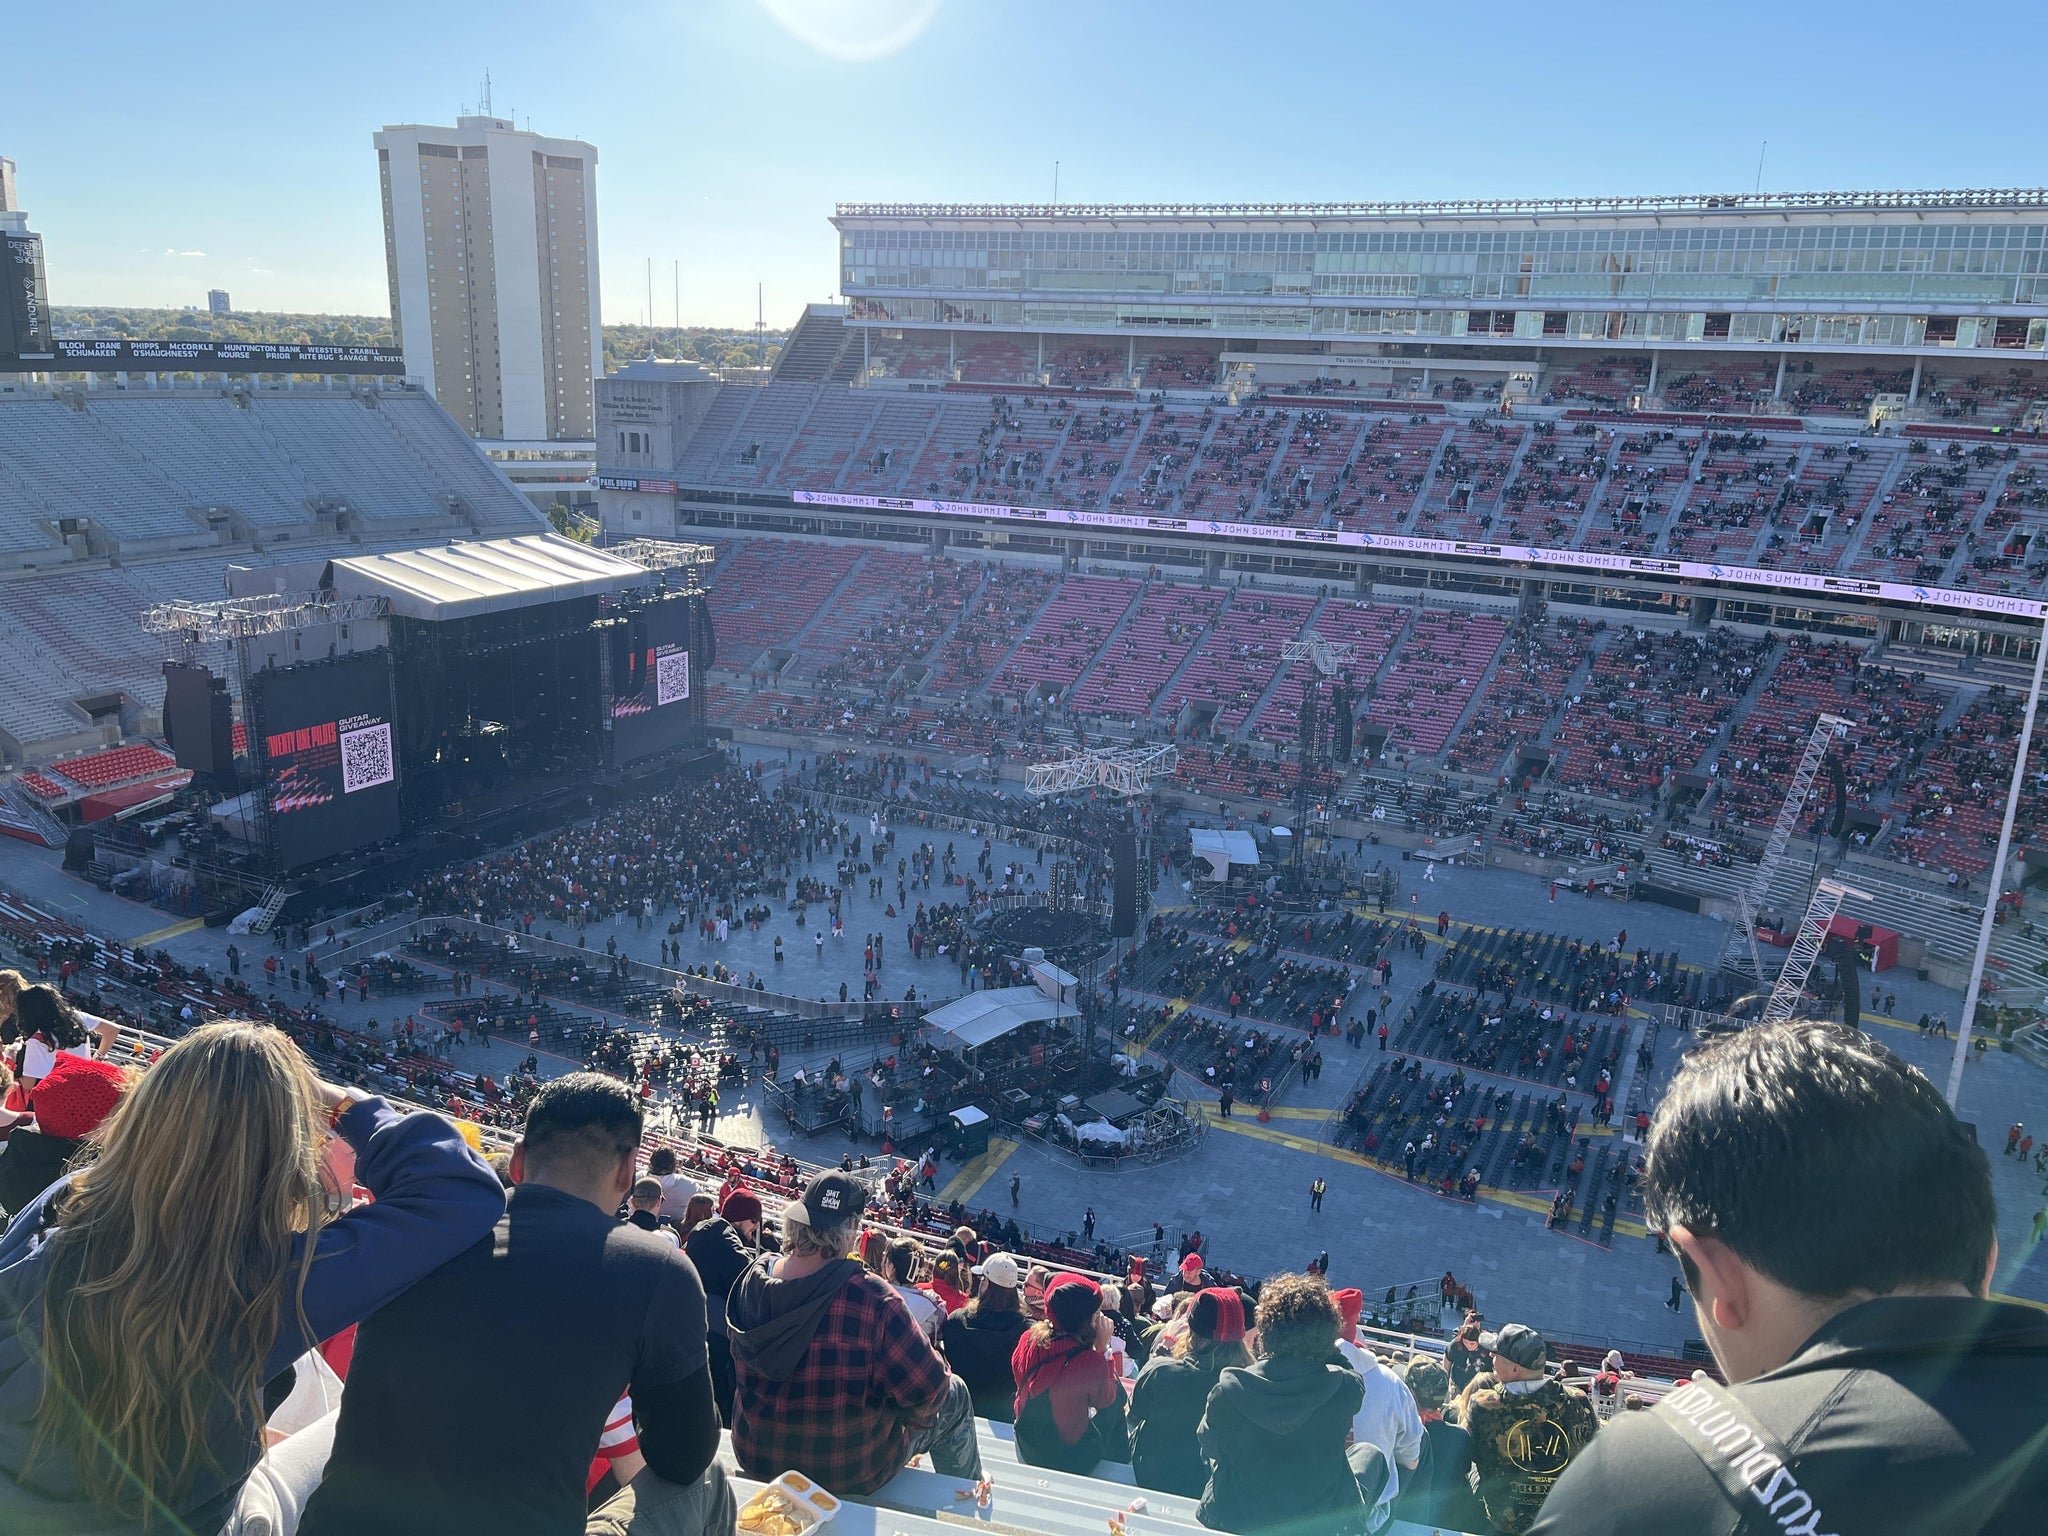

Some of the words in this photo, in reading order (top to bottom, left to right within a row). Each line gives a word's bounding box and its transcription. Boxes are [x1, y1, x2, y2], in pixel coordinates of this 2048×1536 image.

[26, 290, 38, 336] ANDURIL
[169, 343, 214, 351] McCORKLE
[224, 344, 276, 352] HUNTINGTON
[307, 346, 343, 354] WEBSTER
[133, 350, 199, 358] O'SHAUGHNESSY
[218, 351, 250, 359] NOURSE
[266, 352, 291, 360] PRIOR
[300, 352, 317, 360] RITE
[318, 353, 334, 361] RUG
[616, 480, 637, 488] BROWN
[816, 494, 838, 502] JOHN
[841, 497, 876, 505] SUMMIT
[972, 506, 1008, 516] SUMMIT
[1080, 515, 1105, 523] JOHN
[1108, 516, 1145, 526] SUMMIT
[1223, 525, 1249, 534] JOHN
[1252, 527, 1293, 537] SUMMIT
[1376, 537, 1404, 547] JOHN
[1408, 540, 1452, 551] SUMMIT
[1543, 551, 1574, 562] JOHN
[1578, 555, 1626, 567] SUMMIT
[1727, 569, 1761, 581] JOHN
[1766, 574, 1820, 587] SUMMIT
[1933, 592, 1971, 605] JOHN
[1976, 598, 2036, 613] SUMMIT
[339, 713, 369, 726] GUITAR
[339, 716, 381, 732] GIVEAWAY
[266, 731, 295, 757] TWENTY
[296, 728, 311, 751] ONE
[311, 722, 337, 748] PILOTS
[826, 1189, 840, 1198] SHIT
[822, 1196, 840, 1207] SHOW
